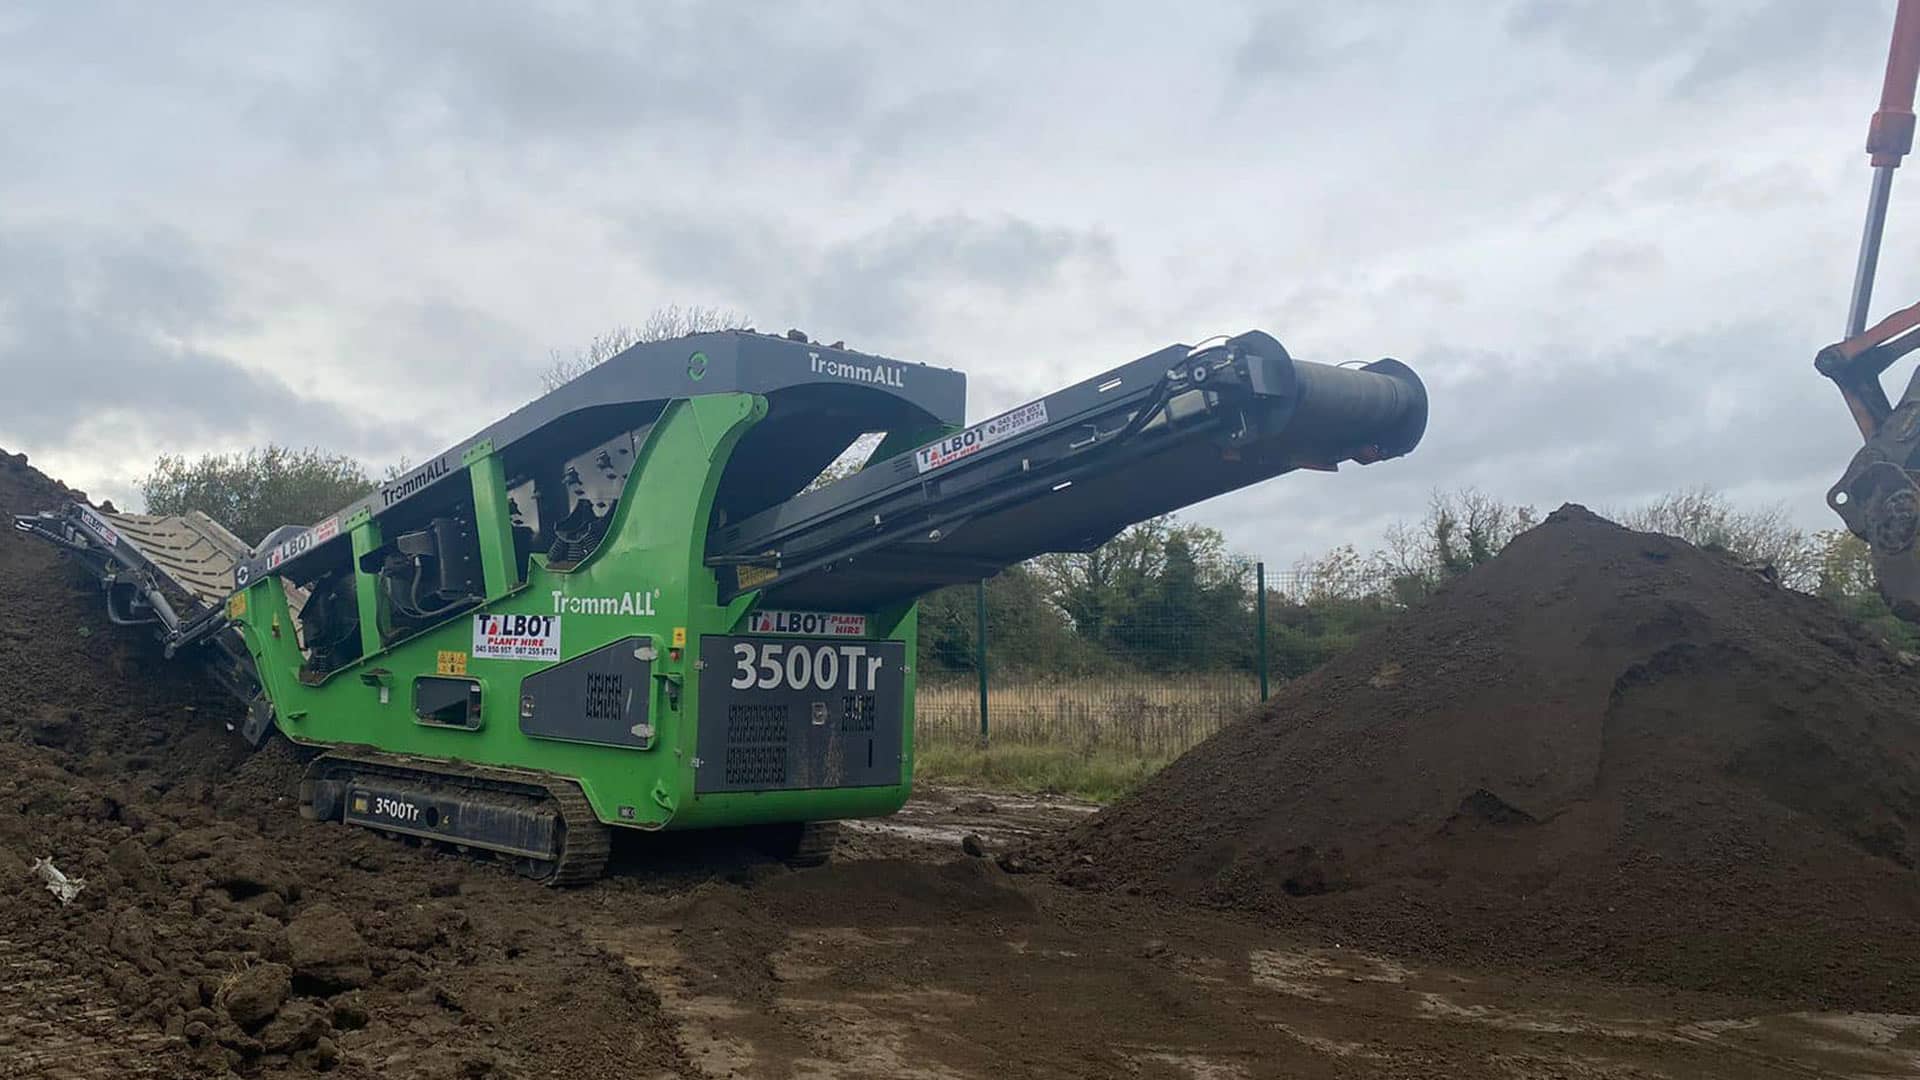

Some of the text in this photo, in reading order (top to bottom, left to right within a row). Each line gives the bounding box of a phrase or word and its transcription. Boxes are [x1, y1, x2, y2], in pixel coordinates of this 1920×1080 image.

[808, 352, 904, 387] TrommALL
[920, 428, 984, 464] TALBOT
[382, 458, 450, 506] TrommALL
[552, 591, 655, 616] TrommALL
[479, 614, 555, 637] TALBOT
[752, 612, 827, 633] TALBOT
[831, 615, 864, 625] PLANT
[834, 626, 861, 634] HIRE
[487, 637, 544, 646] PLANT HIRE
[541, 648, 557, 656] 8774
[731, 643, 883, 691] 3500Tr
[375, 797, 420, 822] 3500Tr
